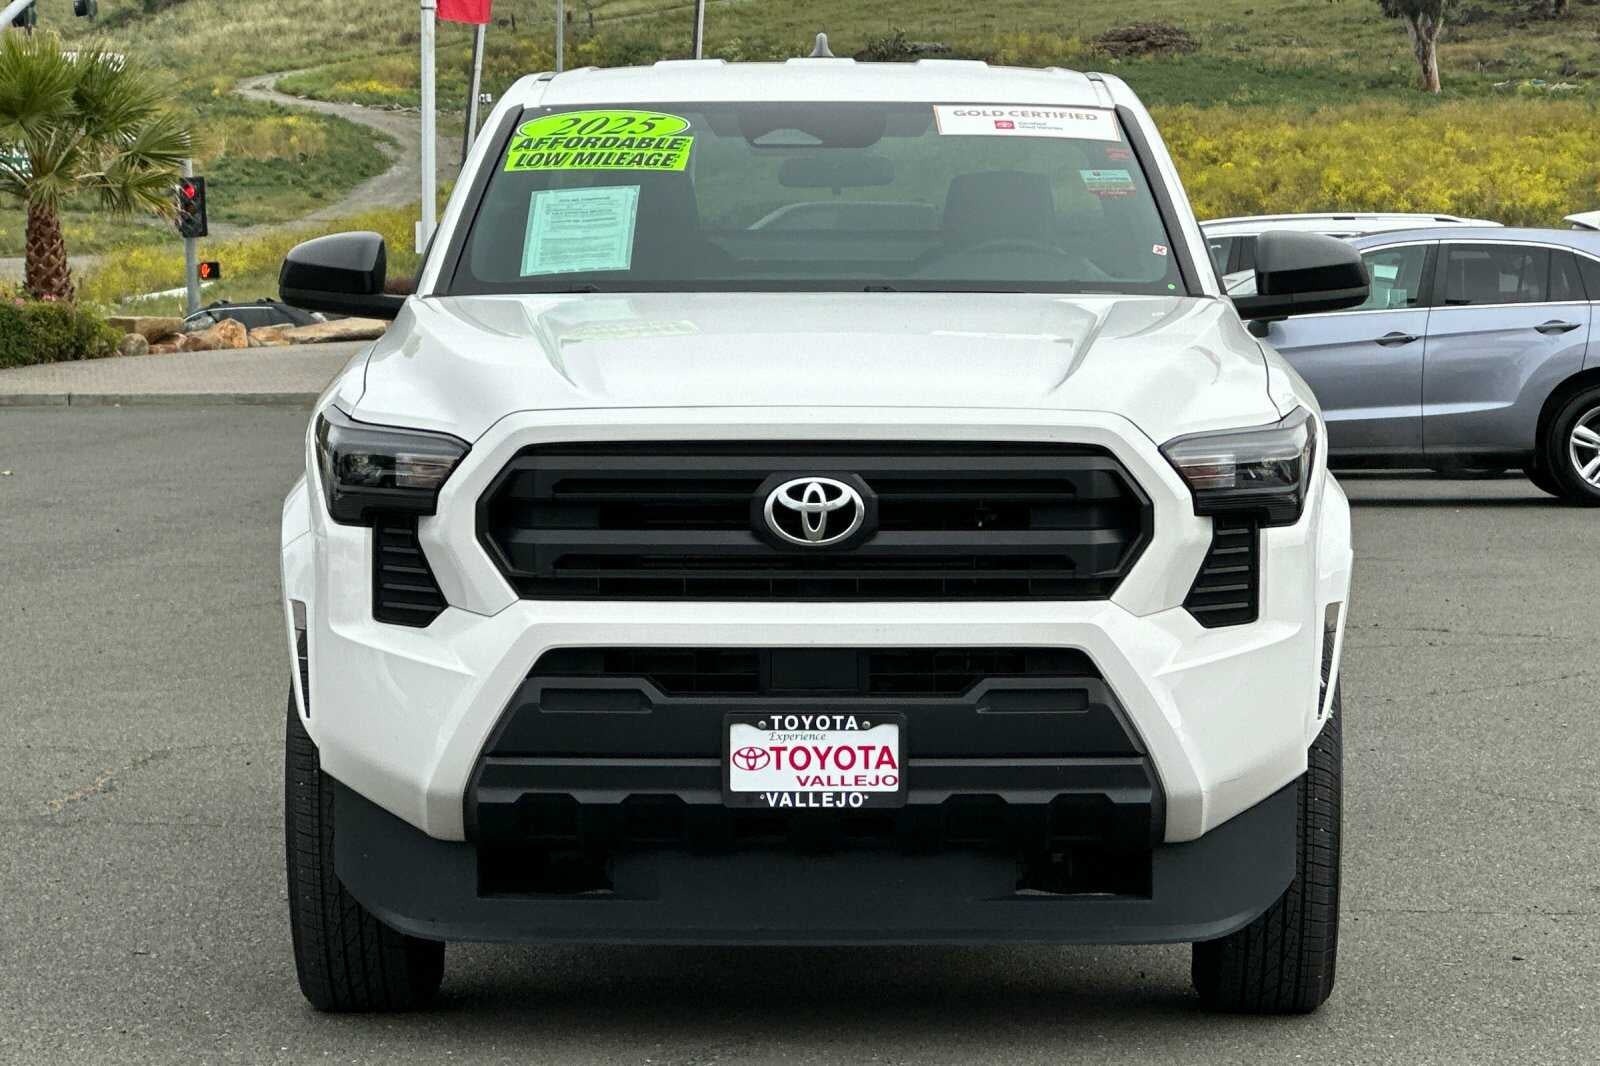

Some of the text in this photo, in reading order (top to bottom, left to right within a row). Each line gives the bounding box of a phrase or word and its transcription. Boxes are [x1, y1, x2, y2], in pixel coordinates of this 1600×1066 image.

[953, 109, 1098, 121] GOLD CERTIFIED
[549, 116, 666, 136] 2025
[513, 136, 689, 151] AFFORDABLE
[513, 151, 681, 168] LOW MILEAGE
[770, 715, 859, 731] TOYOTA
[769, 731, 827, 743] Experience
[769, 745, 898, 771] TOYOTA
[795, 775, 899, 787] VALLEJO
[766, 792, 864, 808] VALLEJO
